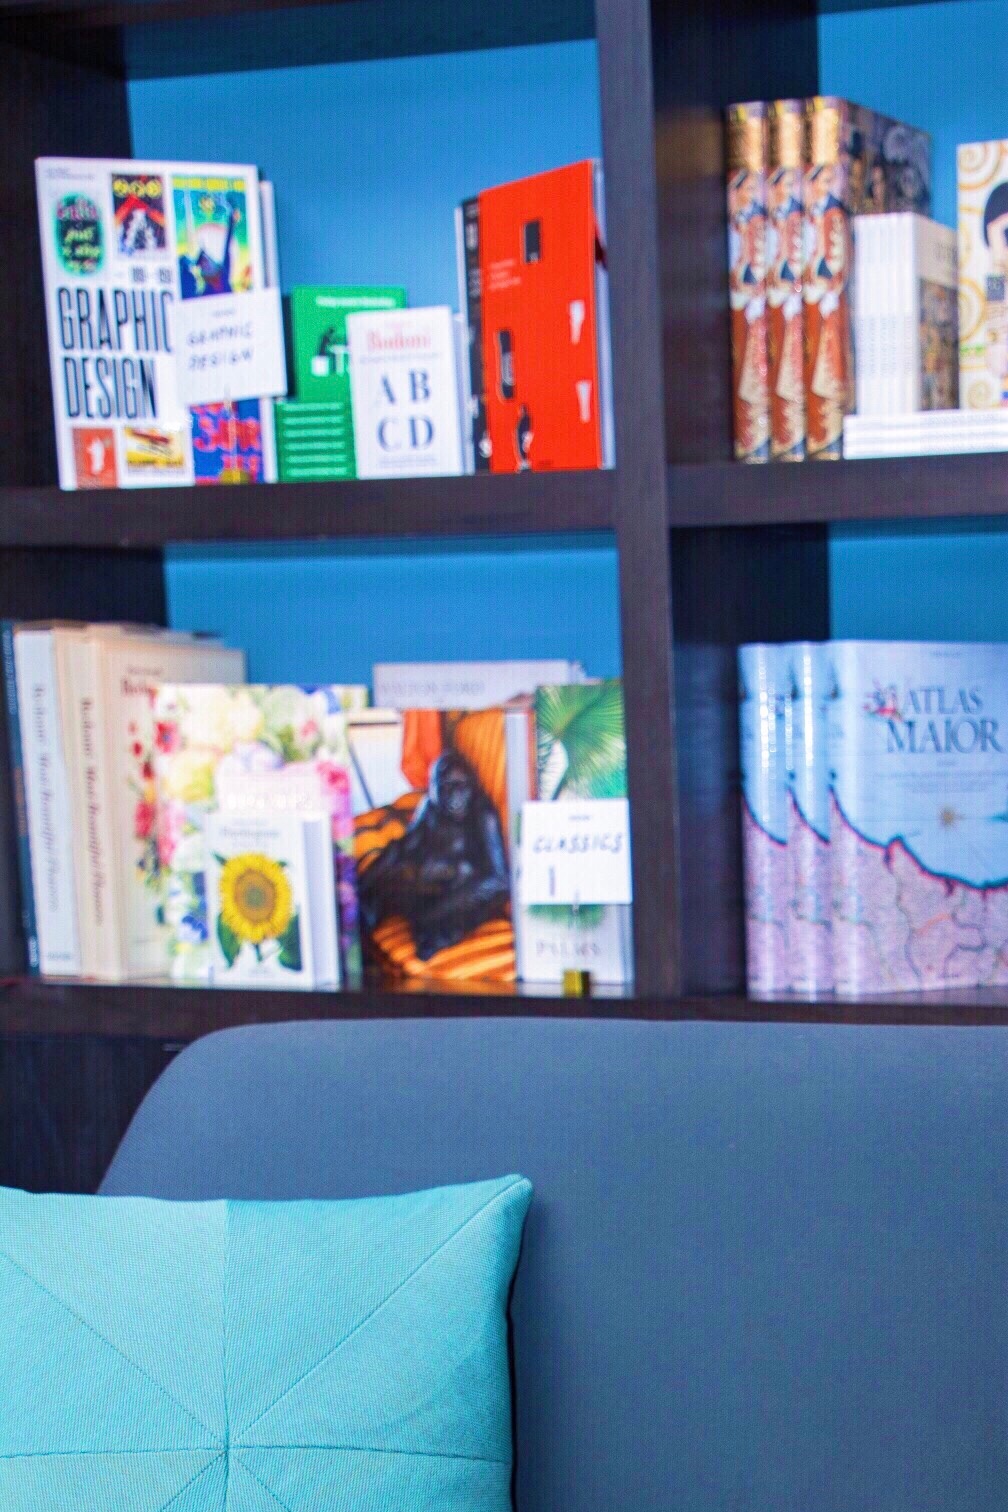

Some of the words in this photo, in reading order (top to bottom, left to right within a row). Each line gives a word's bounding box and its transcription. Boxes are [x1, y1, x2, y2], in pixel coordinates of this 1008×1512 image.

[57, 287, 174, 353] GRAPHIC
[64, 356, 158, 419] DESIGN
[903, 684, 984, 715] ATLAS
[885, 717, 1007, 754] MAIOR
[533, 832, 624, 854] CLASSICS
